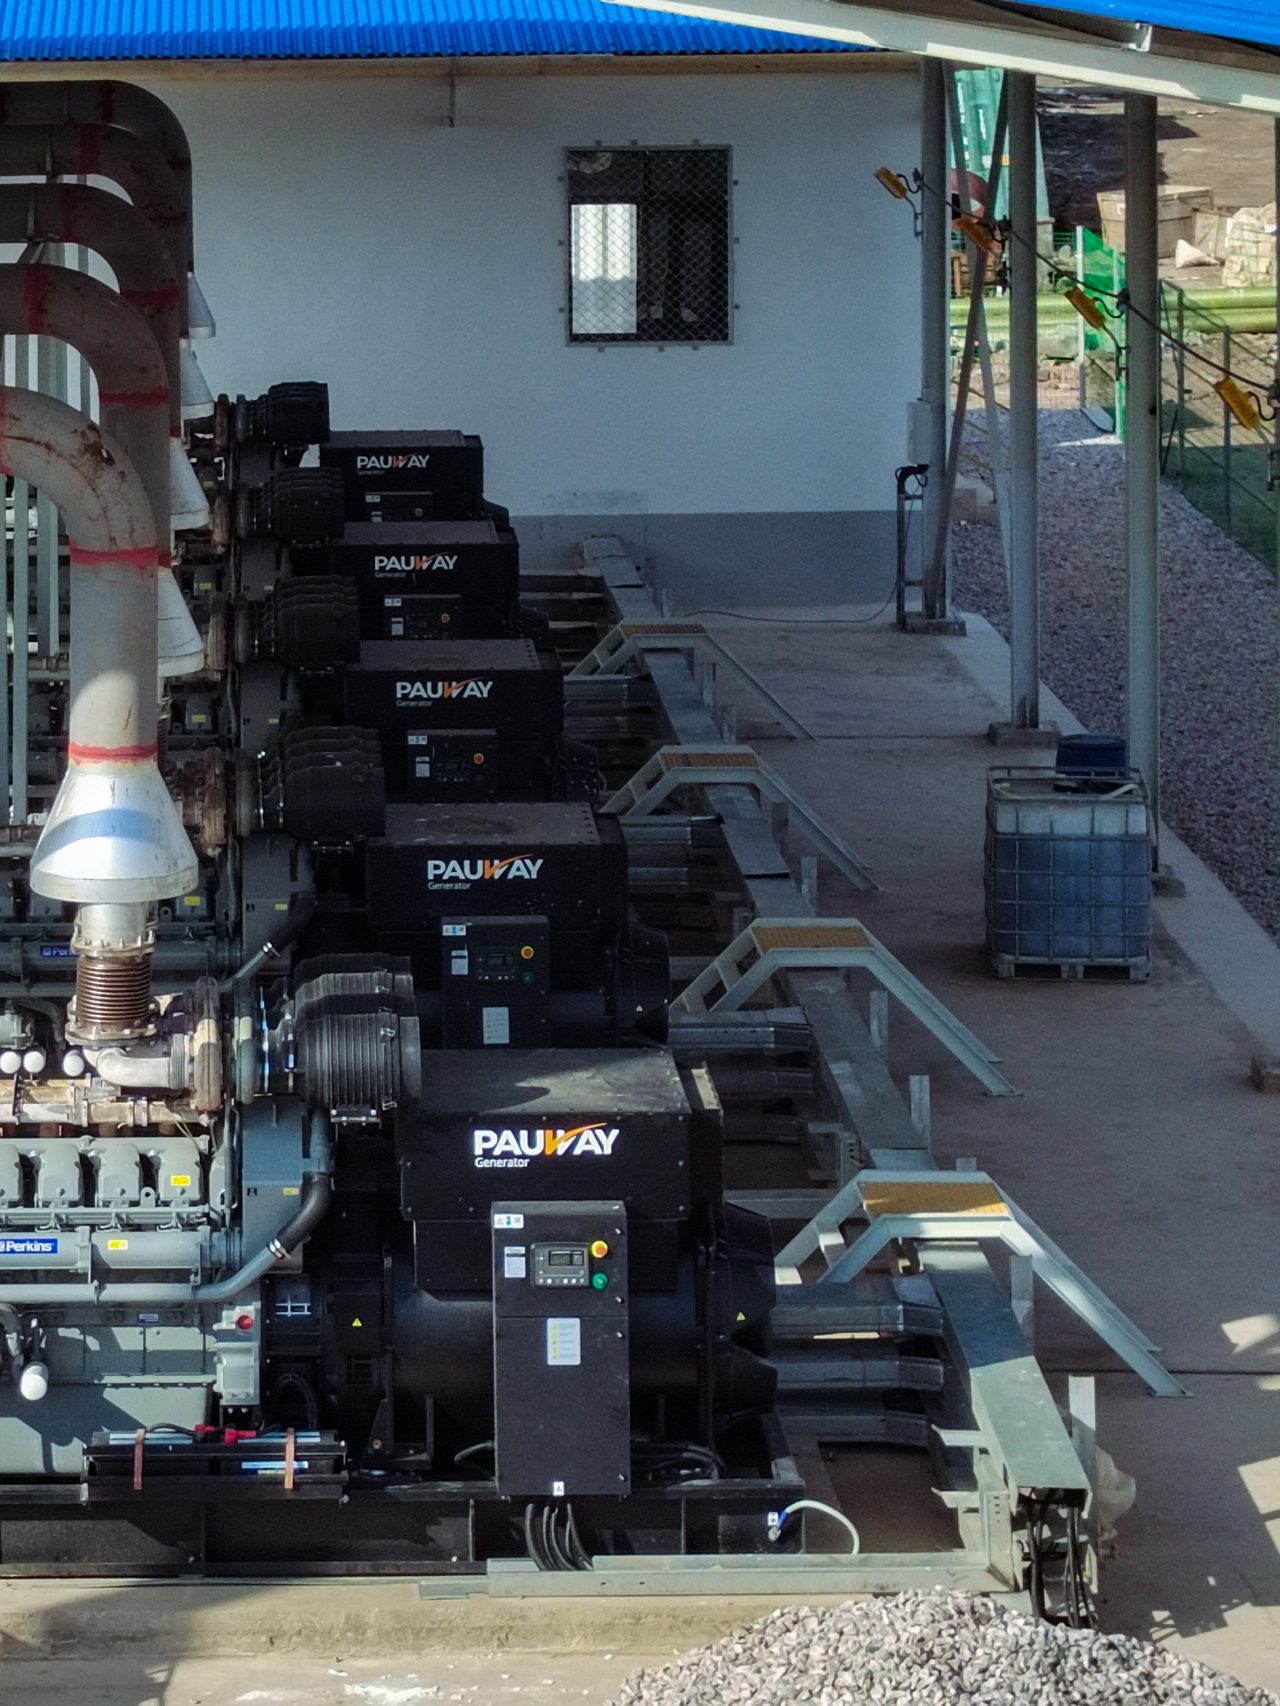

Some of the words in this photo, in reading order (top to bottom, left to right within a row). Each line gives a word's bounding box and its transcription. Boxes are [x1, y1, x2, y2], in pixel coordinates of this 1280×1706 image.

[357, 453, 430, 469] PAUWAY
[374, 552, 458, 571] PAUWAY
[396, 677, 493, 699] PAUWAY
[396, 699, 433, 707] Generator
[427, 854, 544, 881] PAUWAY
[427, 881, 471, 891] Generator
[474, 1122, 620, 1157] PAUWAY
[474, 1157, 530, 1168] Generator
[6, 1241, 52, 1252] Perkins
